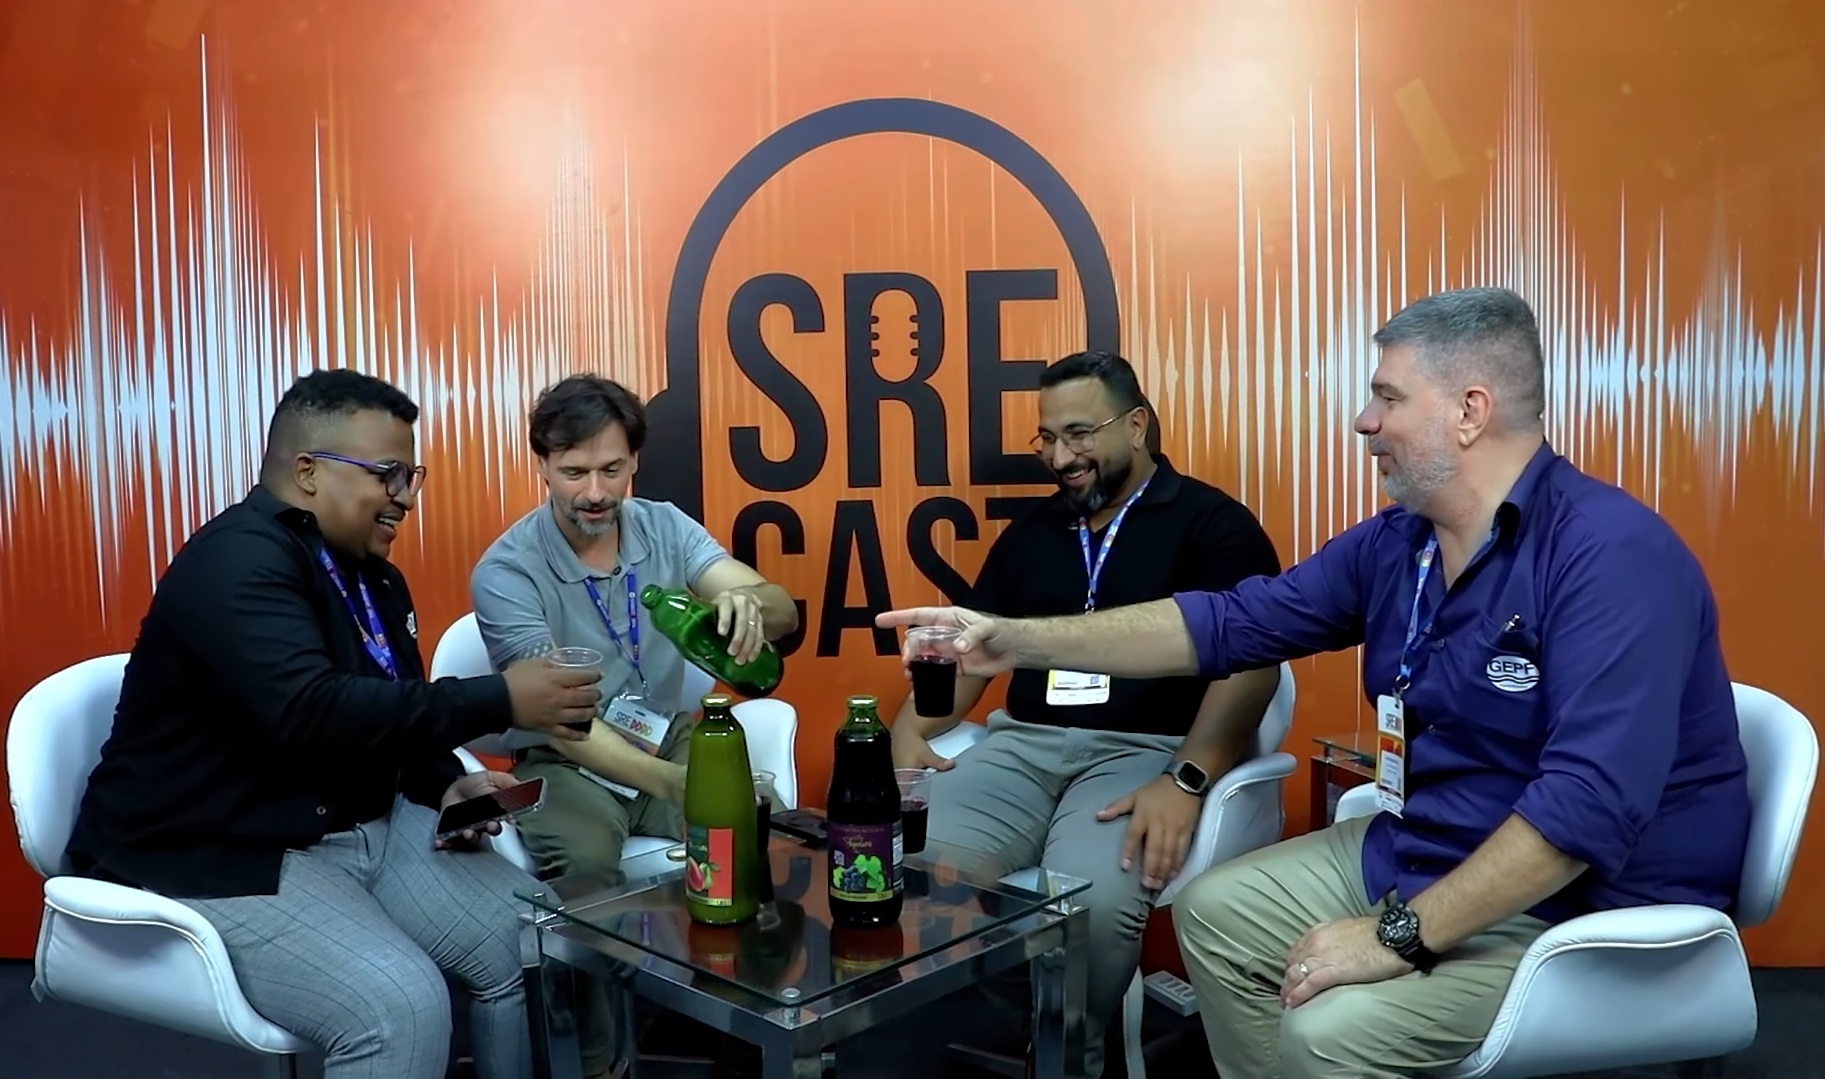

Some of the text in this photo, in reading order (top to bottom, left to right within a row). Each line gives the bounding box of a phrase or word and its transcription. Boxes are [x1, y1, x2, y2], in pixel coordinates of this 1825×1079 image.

[727, 269, 1058, 491] SRE
[731, 496, 1040, 657] CAS
[1490, 660, 1535, 675] GEPF
